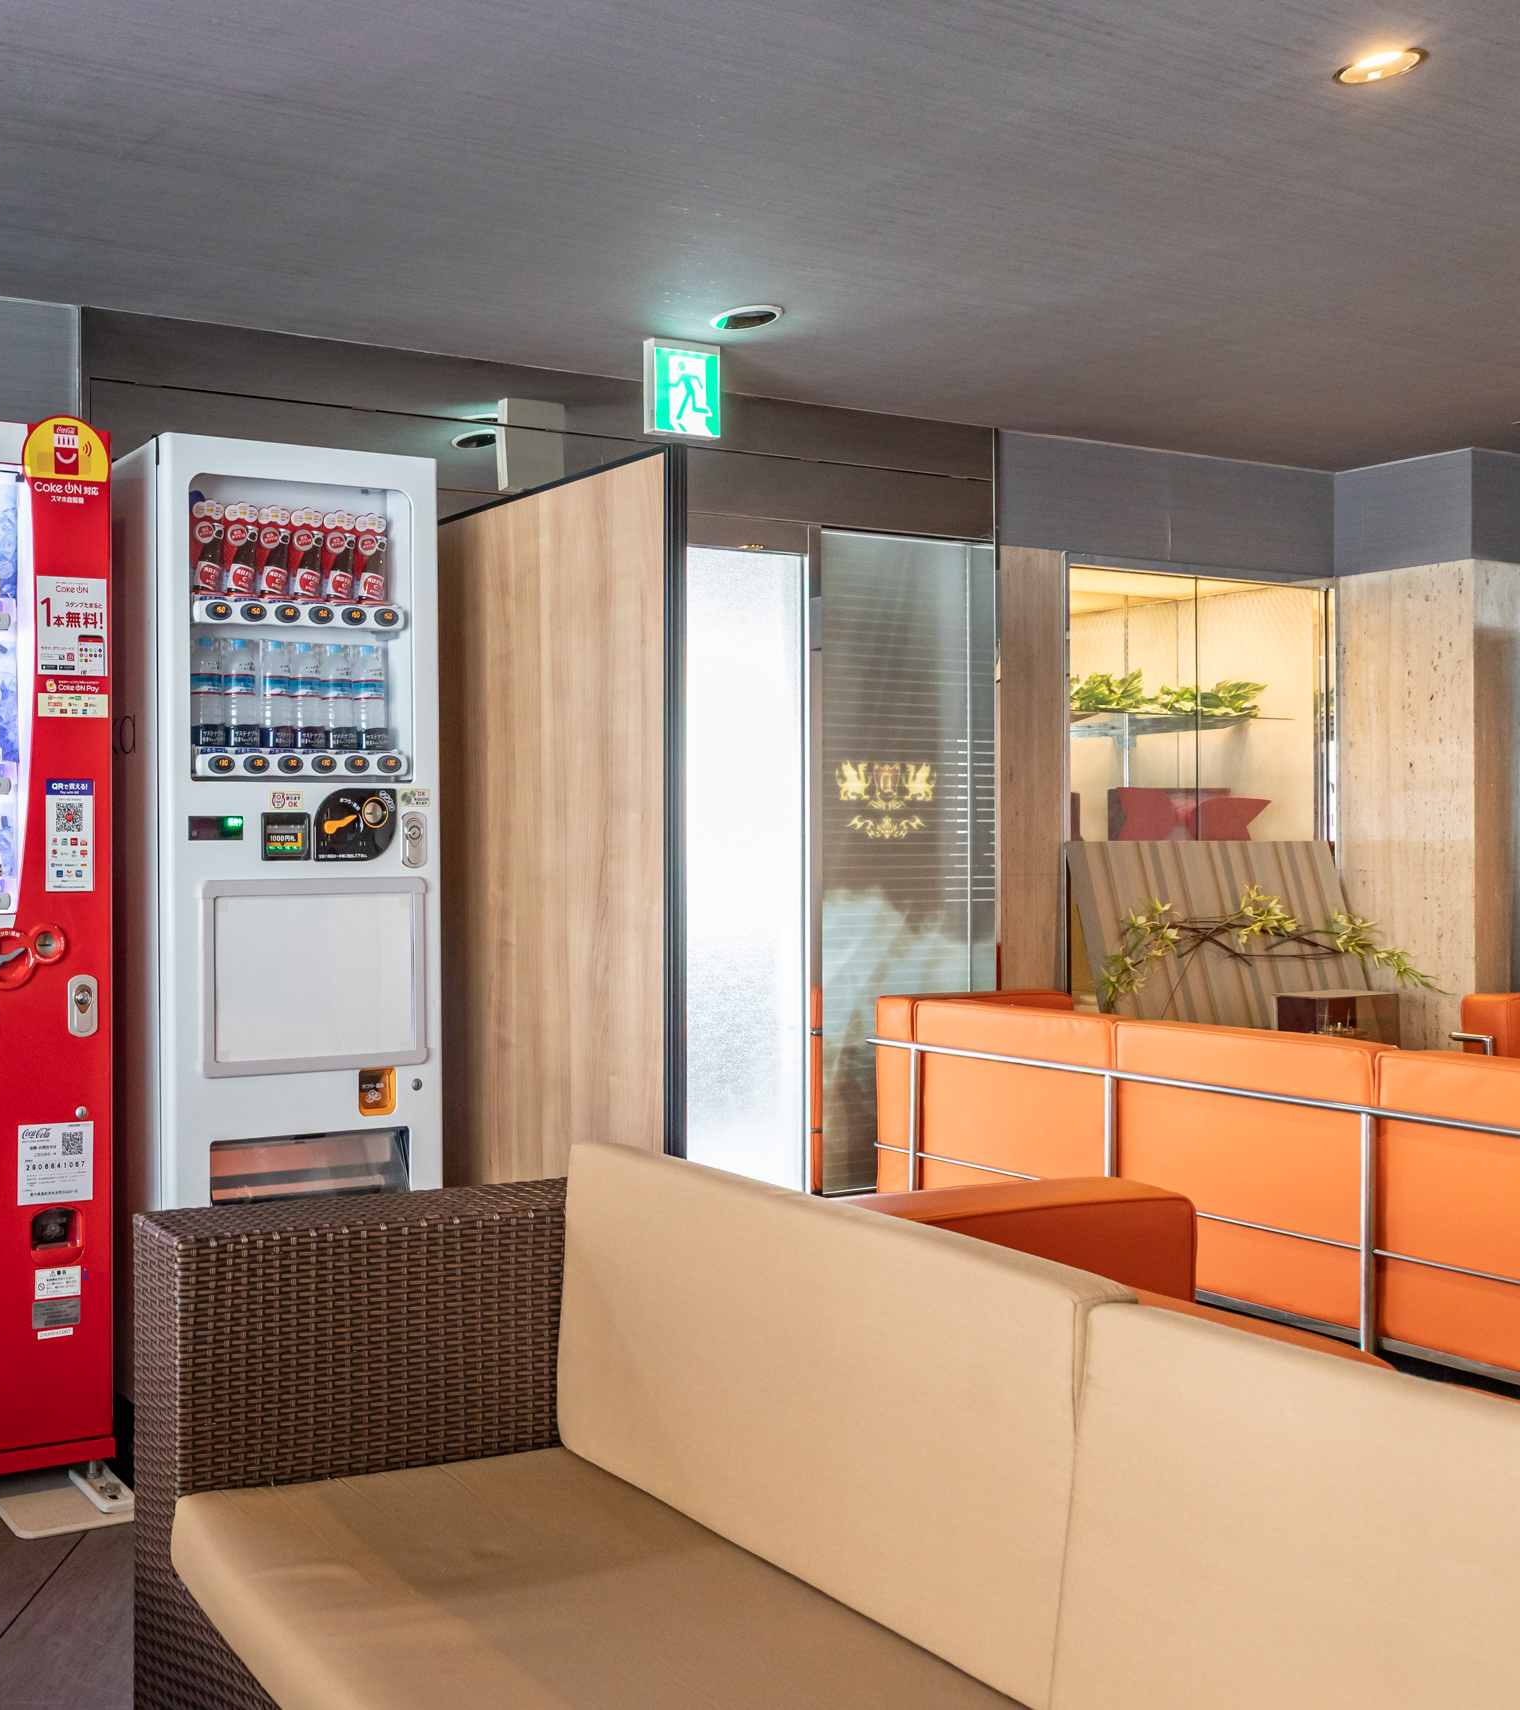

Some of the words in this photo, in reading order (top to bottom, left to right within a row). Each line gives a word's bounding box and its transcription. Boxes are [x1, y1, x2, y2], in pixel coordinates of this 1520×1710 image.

[34, 482, 63, 493] Coke
[64, 482, 82, 494] ON
[84, 486, 99, 496] 対応
[51, 496, 84, 504] スマホ自販機
[77, 586, 89, 594] ON
[41, 597, 103, 629] 1本無料!
[87, 685, 99, 693] Pay
[22, 1128, 52, 1139] Coca-Cola
